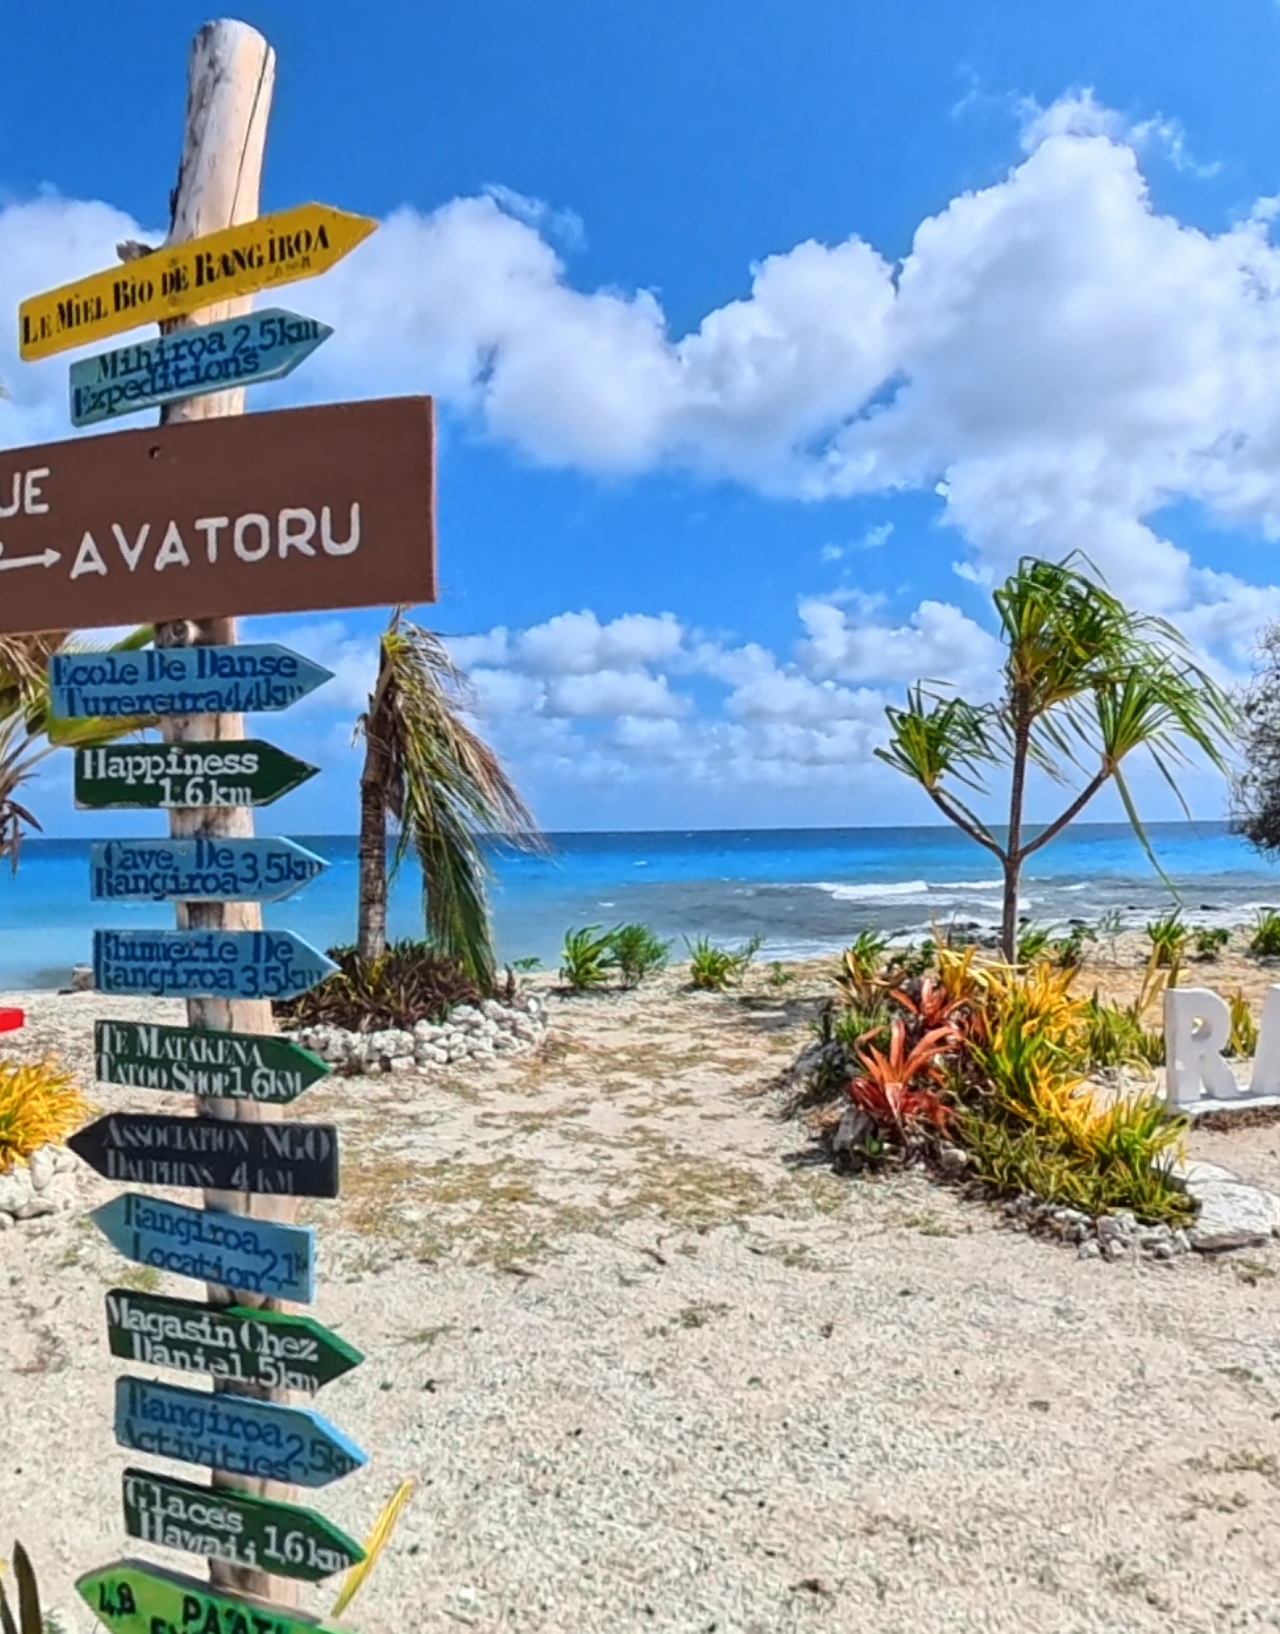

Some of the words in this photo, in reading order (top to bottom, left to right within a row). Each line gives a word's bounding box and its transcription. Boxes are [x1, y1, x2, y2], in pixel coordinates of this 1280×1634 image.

[96, 331, 226, 381] Mihiroa
[73, 352, 260, 418] Expeditions
[70, 502, 360, 580] AVATORU
[53, 655, 139, 686] Ecole
[146, 650, 186, 682] De
[197, 648, 297, 679] Danse
[83, 748, 259, 785] Happiness
[104, 839, 174, 871] Cave
[196, 839, 234, 870] De
[95, 868, 240, 900] Rangiroa
[94, 931, 238, 964] Rhumerie
[253, 931, 294, 964] De
[94, 961, 235, 996] Rangiroa
[263, 1126, 330, 1161] NGO
[230, 1161, 249, 1190] 4
[124, 1197, 260, 1255] Rangiroa
[133, 1232, 263, 1293] Location
[108, 1295, 236, 1350] Magasin
[240, 1321, 318, 1362] Chez
[129, 1383, 283, 1448] Rangiroa
[123, 1418, 291, 1481] Activities
[126, 1478, 244, 1534] Glaces
